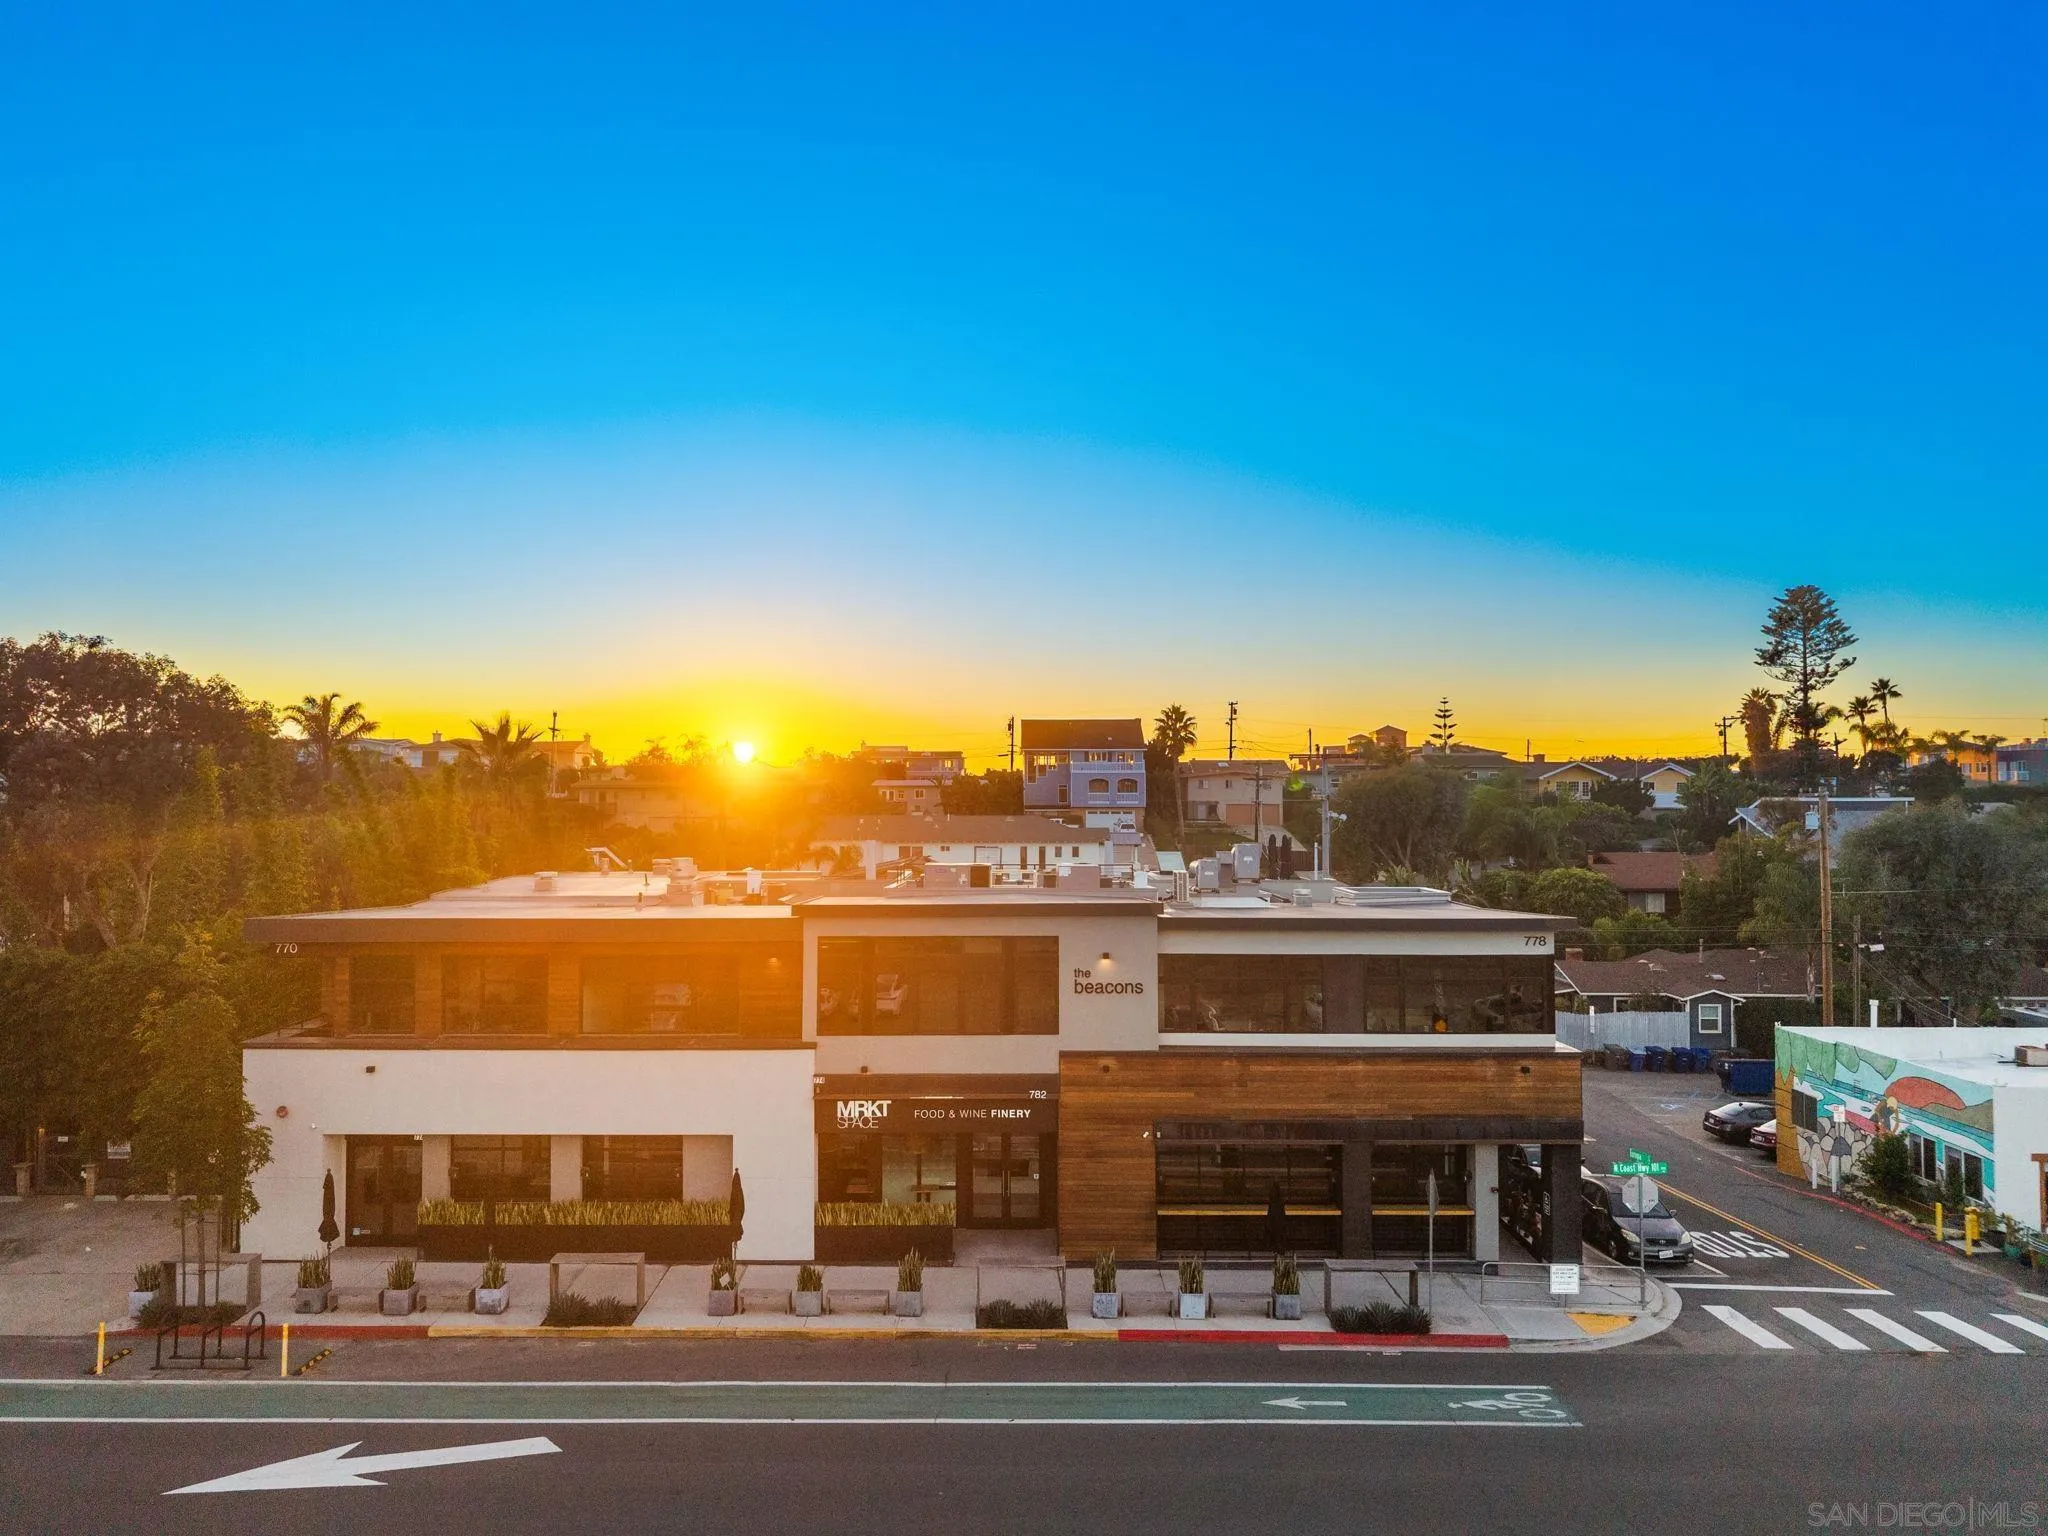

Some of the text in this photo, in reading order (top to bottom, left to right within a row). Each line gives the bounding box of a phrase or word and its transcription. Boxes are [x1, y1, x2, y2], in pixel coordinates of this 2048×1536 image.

[1523, 935, 1547, 947] 778
[275, 942, 298, 954] 770
[1073, 967, 1091, 978] the
[1073, 979, 1144, 994] beacons
[1029, 1090, 1047, 1099] 782
[836, 1100, 892, 1117] MRKT
[914, 1109, 1031, 1119] FOOD & WINE FINERY
[837, 1115, 879, 1129] SPACE
[1619, 1163, 1636, 1173] Coast
